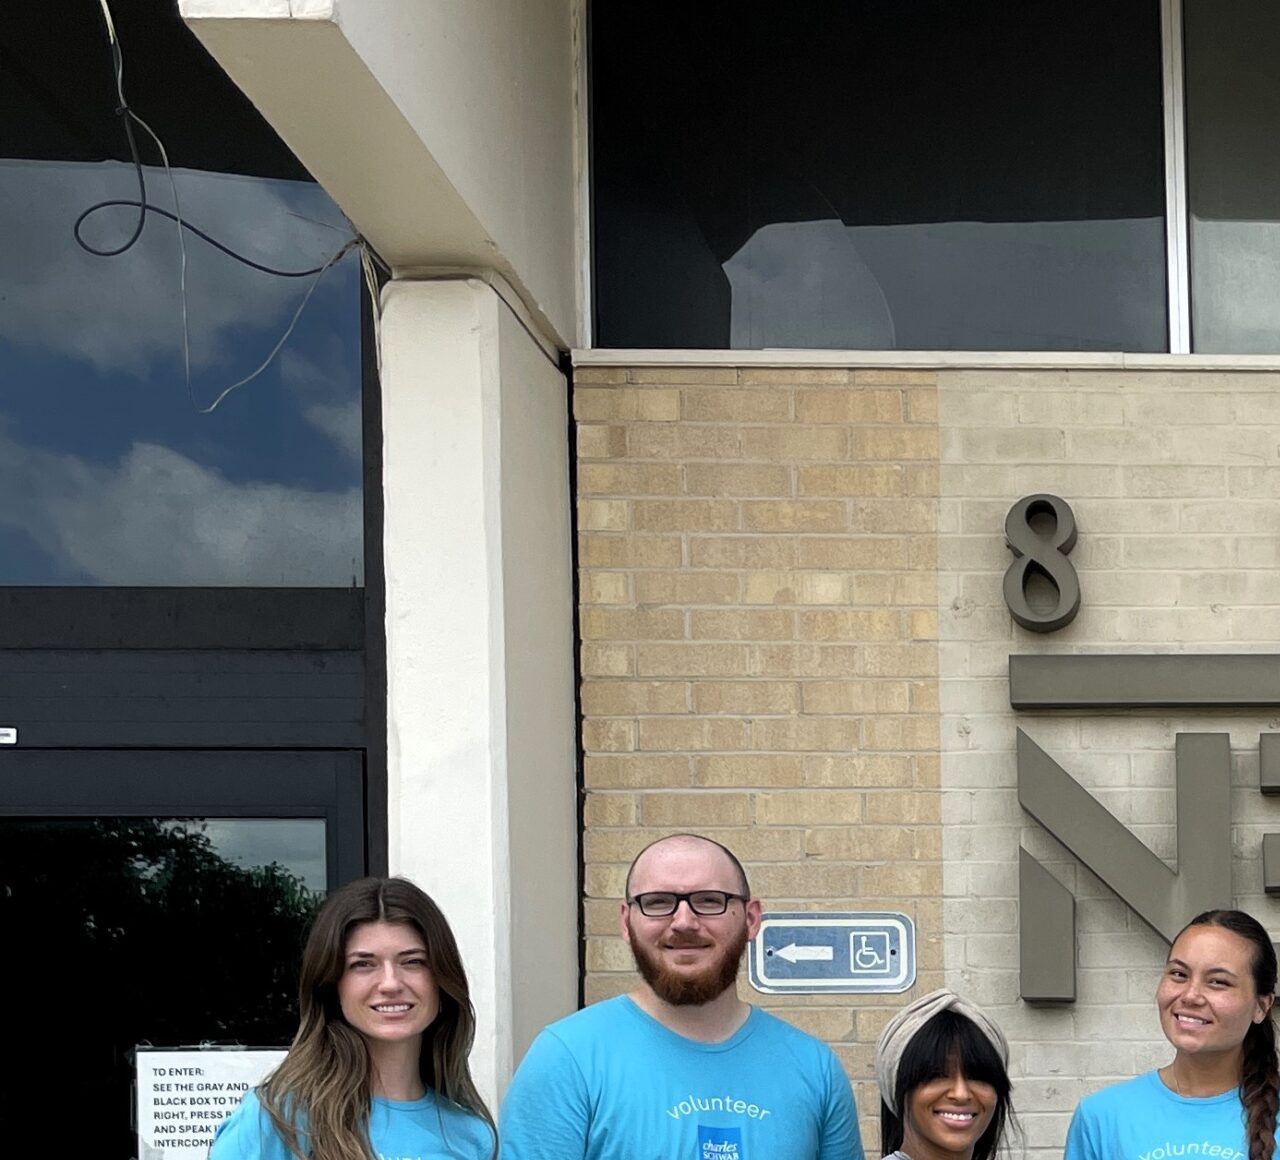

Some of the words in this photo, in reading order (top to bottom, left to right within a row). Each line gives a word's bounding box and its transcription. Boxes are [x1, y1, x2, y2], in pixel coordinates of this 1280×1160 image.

[152, 1067, 166, 1076] TO
[168, 1067, 204, 1076] ENTER:
[153, 1083, 172, 1092] SEE
[174, 1083, 194, 1092] THE
[196, 1083, 224, 1091] GRAY
[226, 1082, 249, 1091] AND
[153, 1097, 187, 1106] BLACK
[189, 1097, 211, 1105] BOX
[212, 1096, 226, 1105] TO
[228, 1096, 242, 1105] TH
[666, 1095, 771, 1120] volunteer
[153, 1111, 188, 1120] RIGHT,
[190, 1110, 223, 1119] PRESS
[153, 1125, 176, 1133] AND
[178, 1125, 212, 1133] SPEAK
